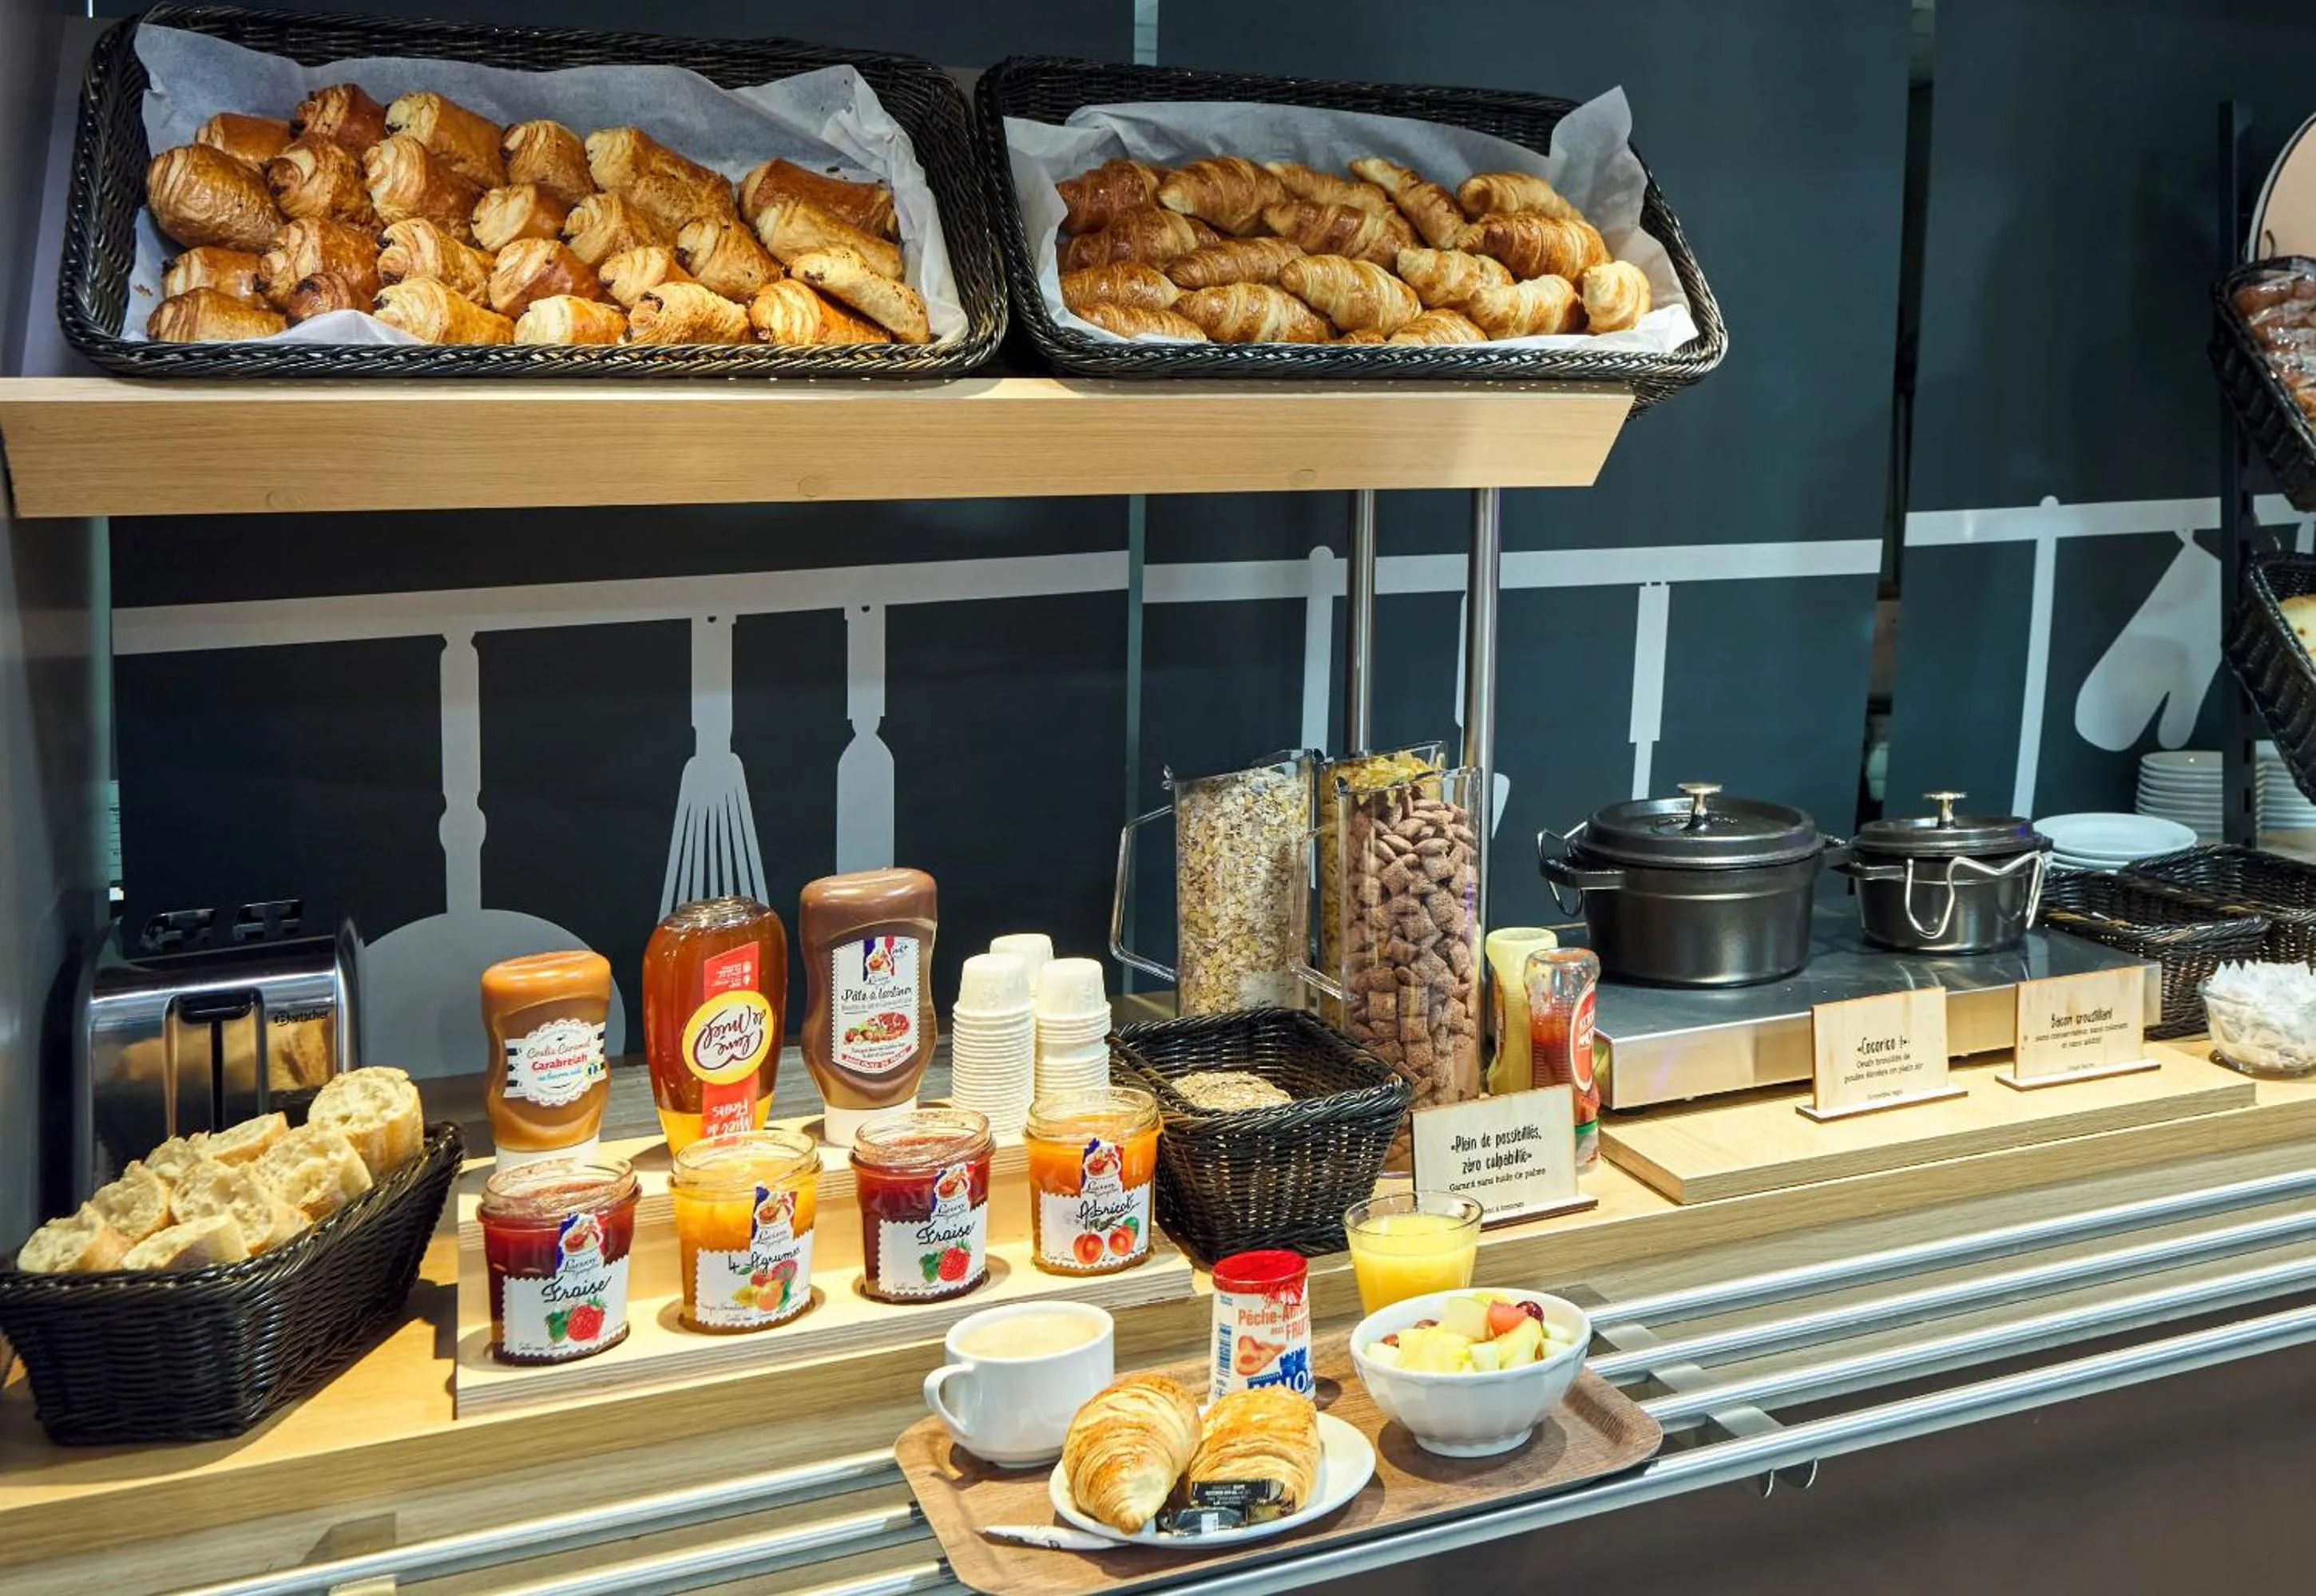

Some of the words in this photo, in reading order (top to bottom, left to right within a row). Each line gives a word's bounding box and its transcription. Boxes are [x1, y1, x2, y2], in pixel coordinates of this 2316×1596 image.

[2051, 1013, 2072, 1028] Bacon
[711, 1098, 749, 1119] Fleurs
[1481, 1131, 1490, 1148] de
[1462, 1158, 1481, 1174] zéro
[1477, 1178, 1493, 1186] sans
[1076, 1194, 1137, 1230] Abricot
[916, 1221, 976, 1246] Fraise
[728, 1254, 740, 1273] 4
[745, 1247, 800, 1275] Agrumes
[541, 1276, 612, 1303] Fraise
